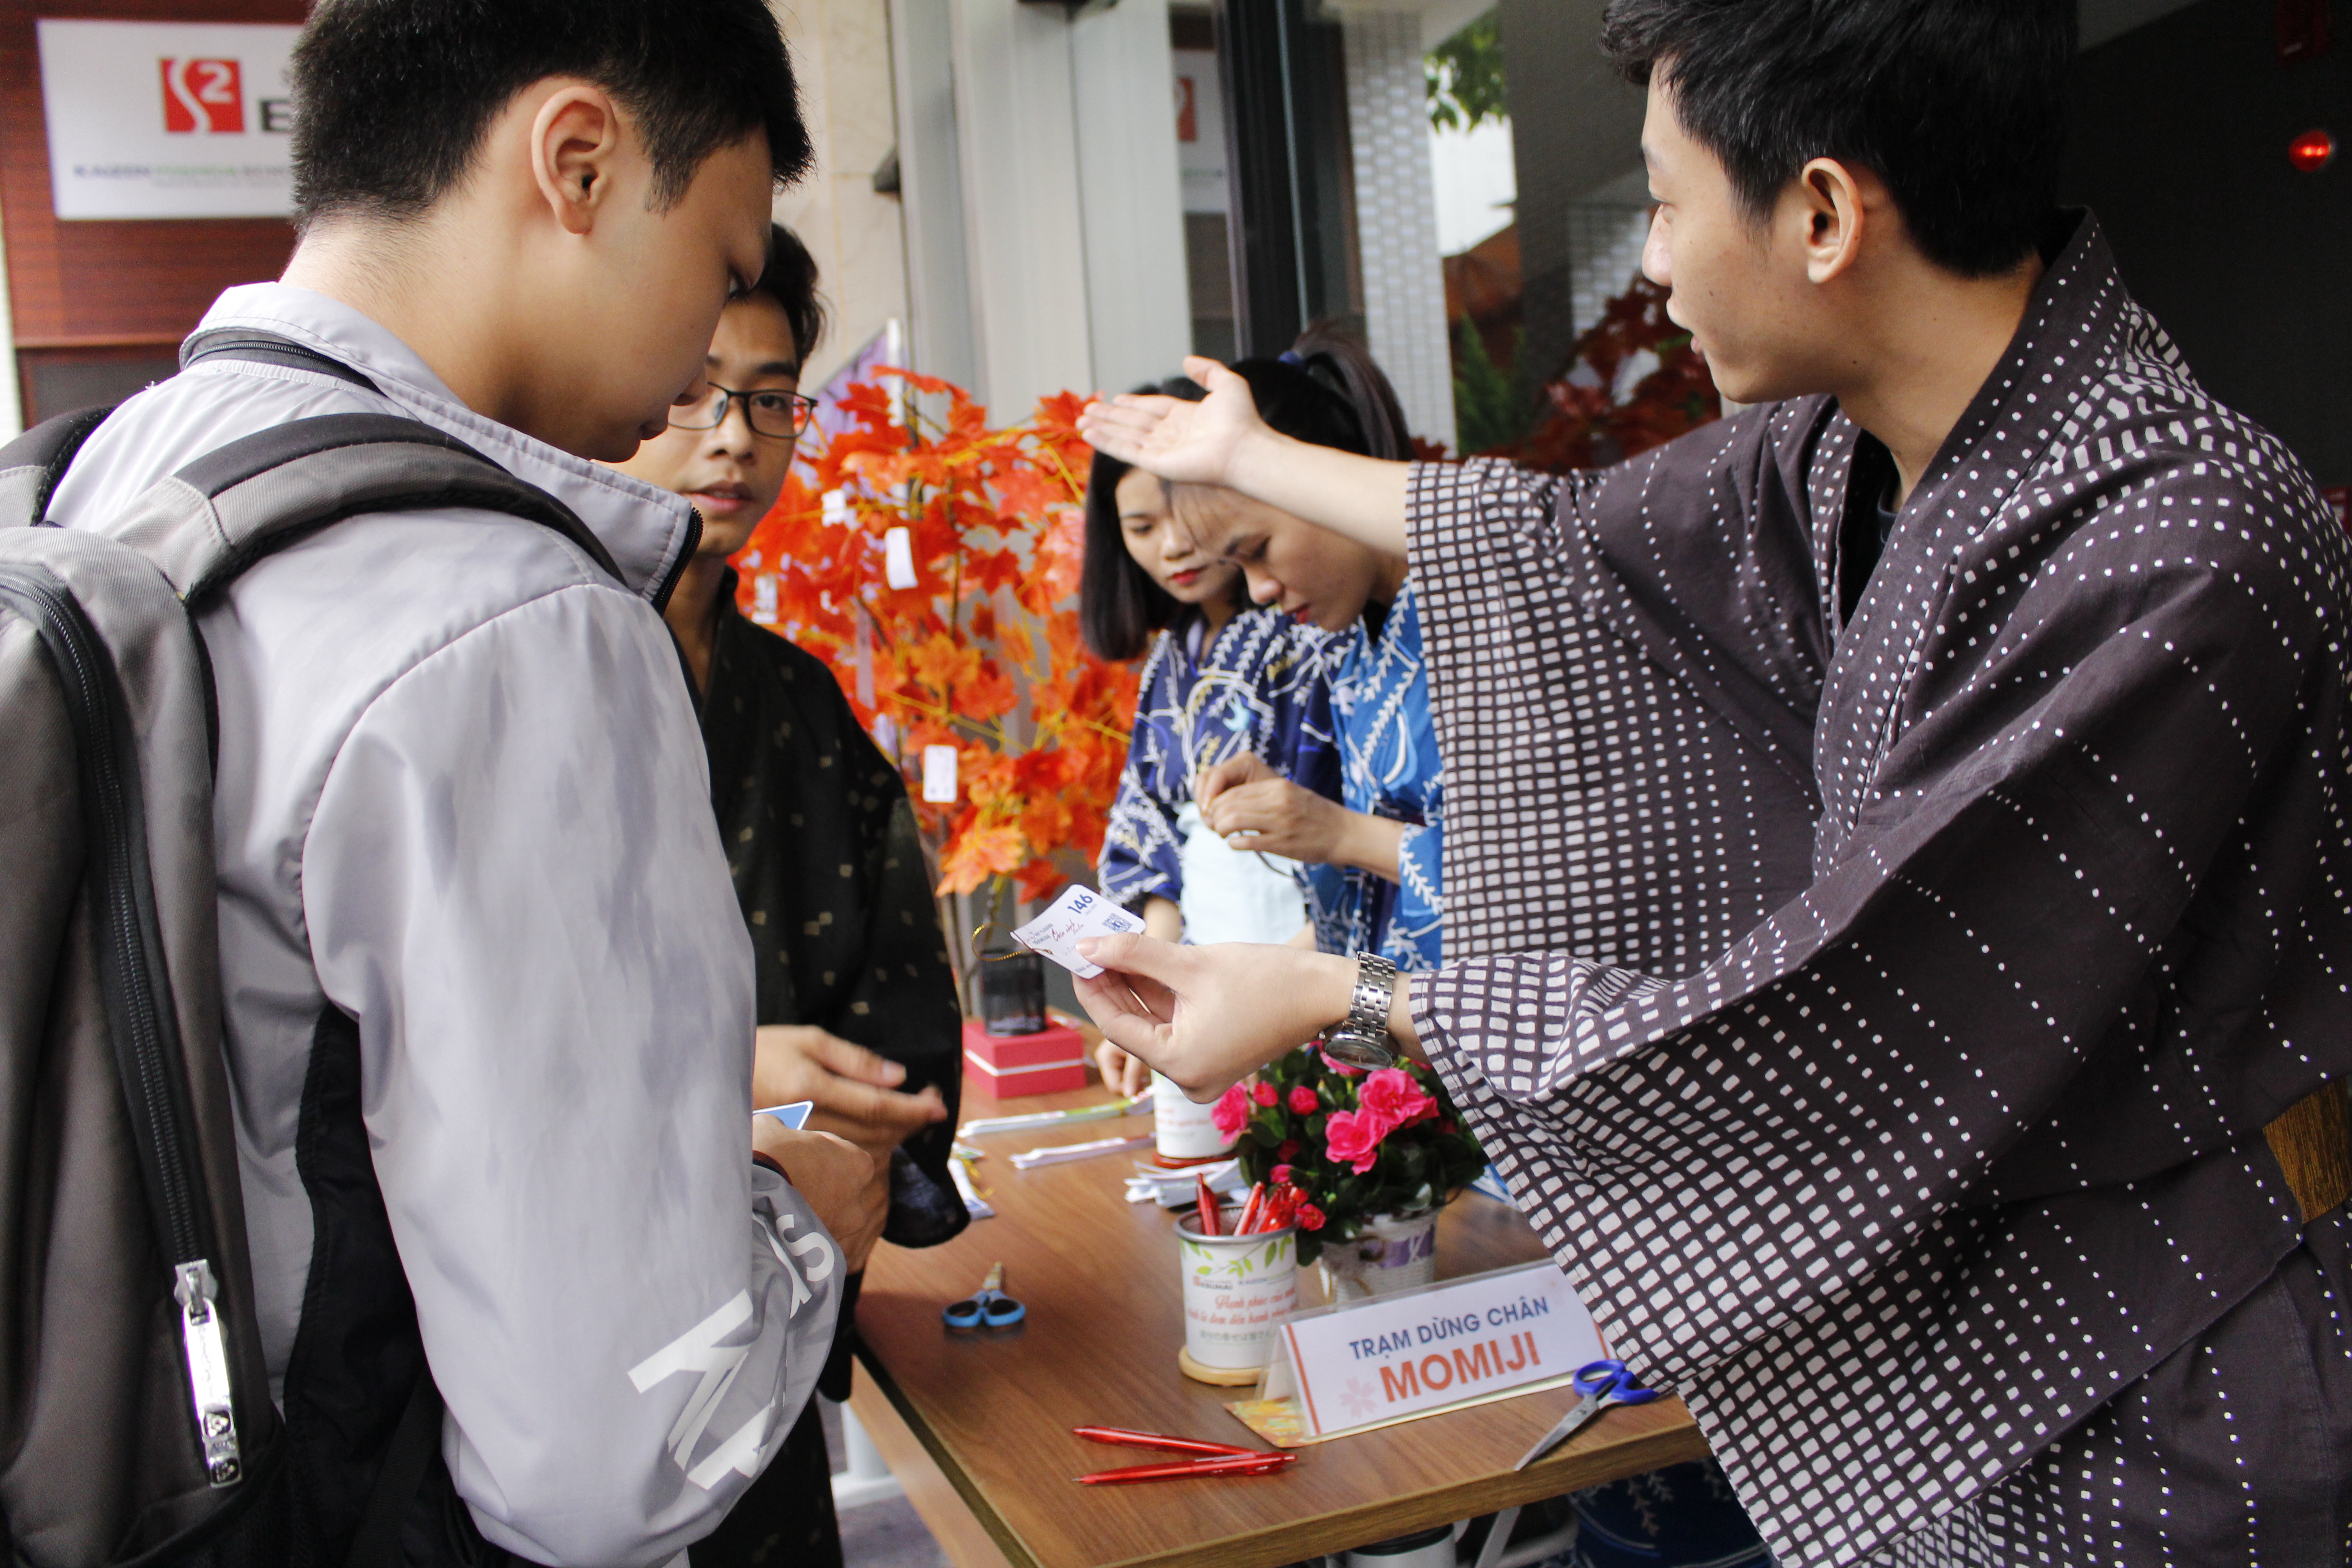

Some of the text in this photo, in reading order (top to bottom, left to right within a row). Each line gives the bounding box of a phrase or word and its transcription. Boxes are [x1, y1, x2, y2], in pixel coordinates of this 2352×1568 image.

[1067, 893, 1093, 914] 146
[1349, 1296, 1549, 1359] TRẠM DỪNG CHÂN
[1379, 1331, 1541, 1403] MOMIJI
